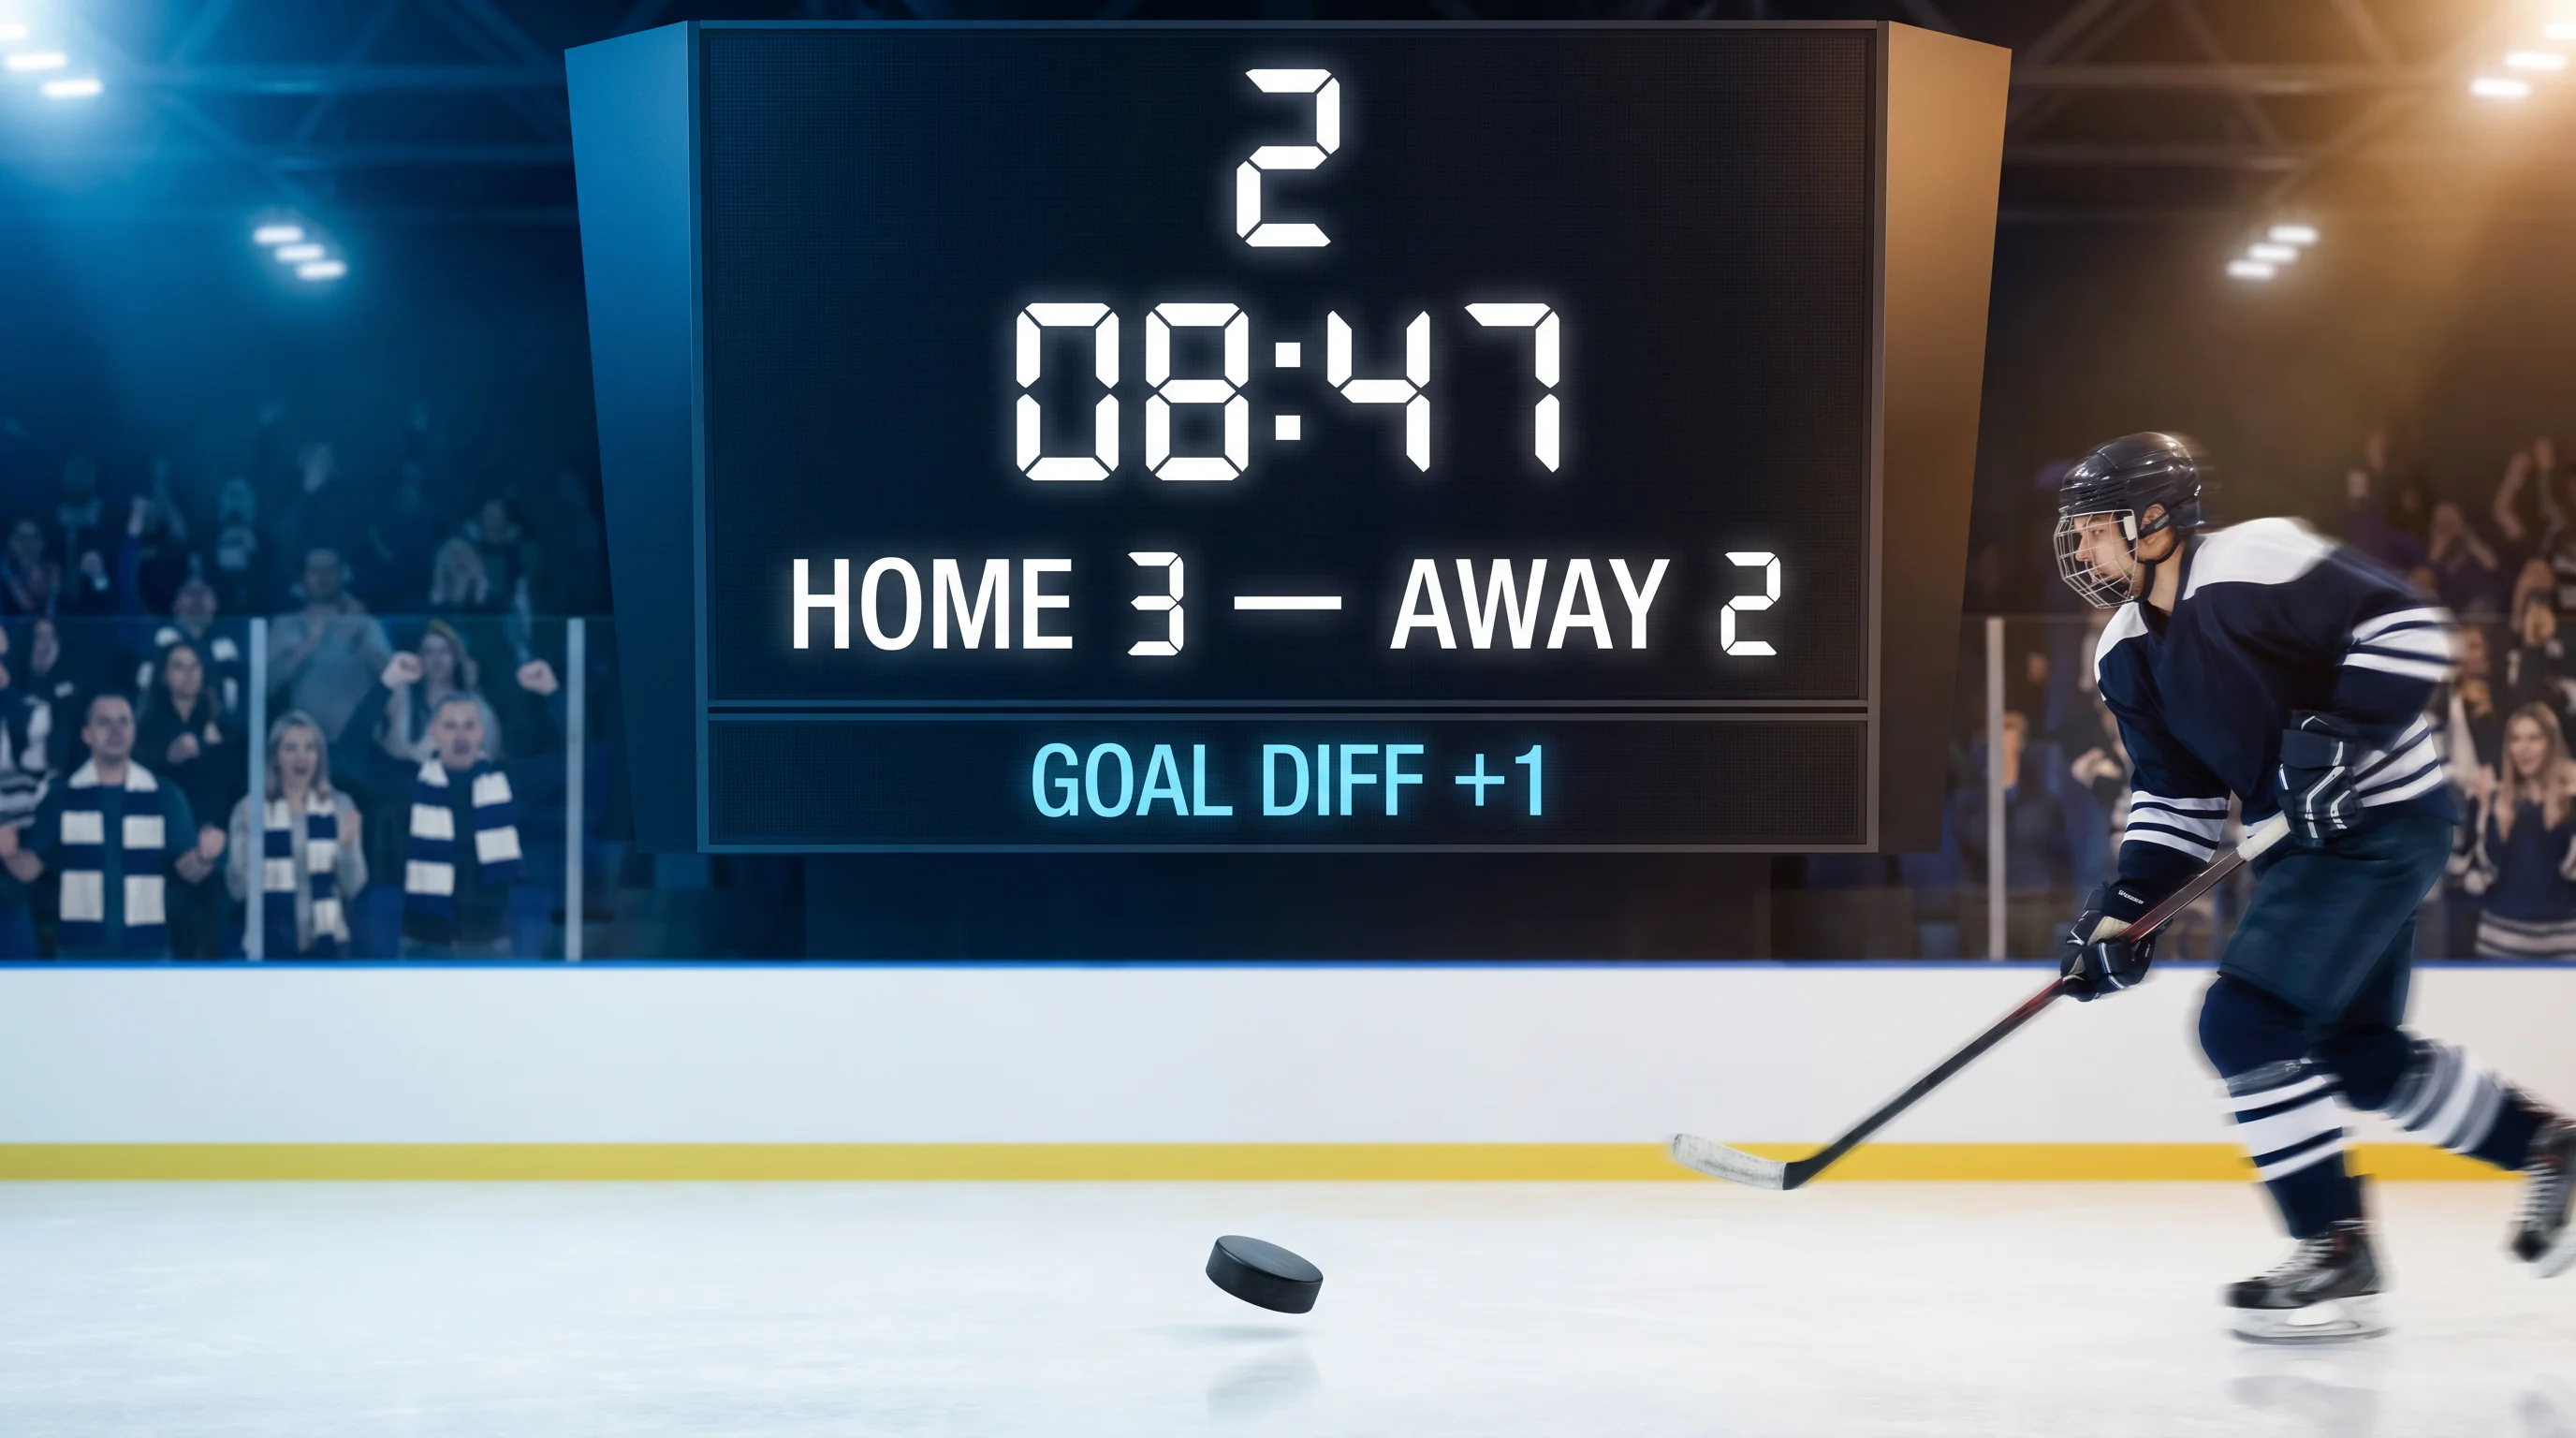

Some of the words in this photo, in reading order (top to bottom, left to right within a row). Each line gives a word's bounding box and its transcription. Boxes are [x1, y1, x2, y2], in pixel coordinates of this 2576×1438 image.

[1237, 69, 1339, 246] 2
[1017, 303, 1560, 480] 08:47
[793, 558, 1073, 650] HOME
[1128, 552, 1184, 655] 3
[1390, 558, 1671, 650] AWAY
[1721, 552, 1780, 655] 2
[1032, 743, 1232, 817] GOAL
[1263, 743, 1425, 816] DIFF
[1456, 744, 1543, 816] +1
